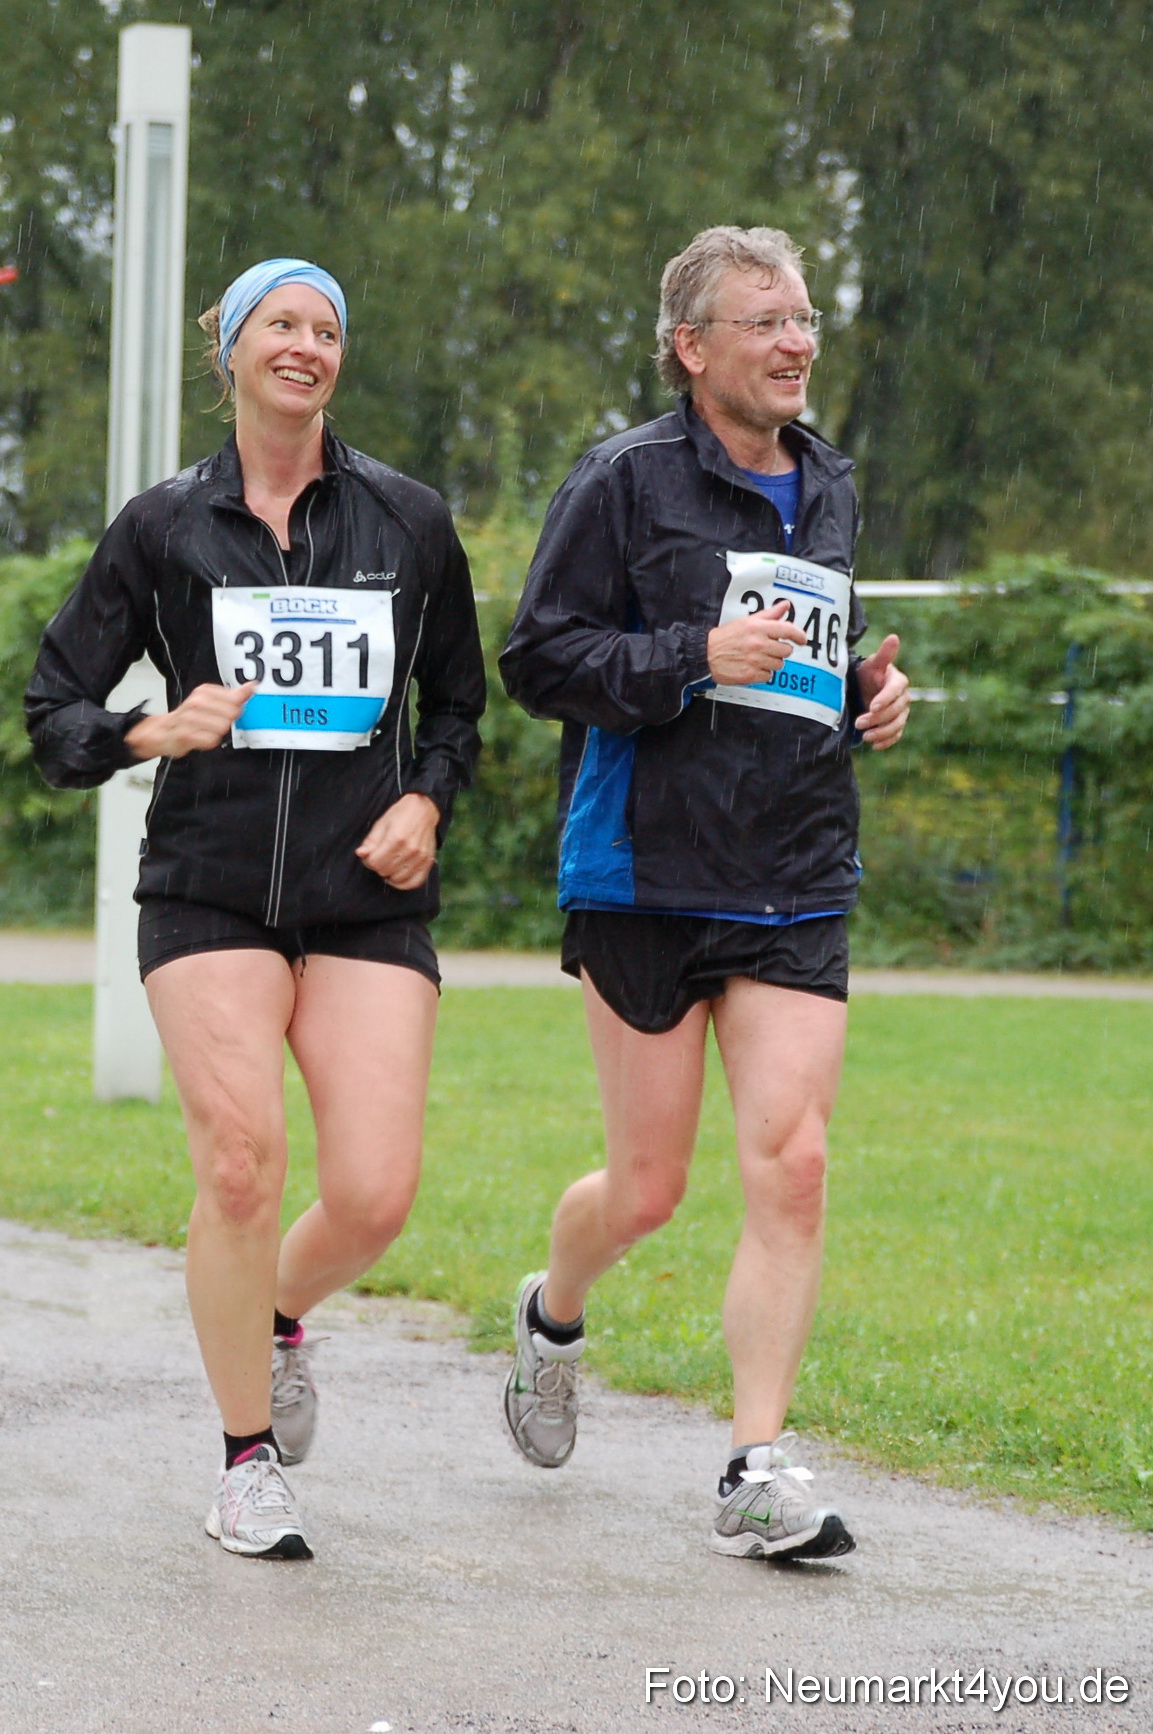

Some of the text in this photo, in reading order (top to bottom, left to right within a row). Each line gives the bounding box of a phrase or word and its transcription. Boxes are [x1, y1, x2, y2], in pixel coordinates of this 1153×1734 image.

[775, 565, 825, 591] BOCK
[271, 598, 338, 614] BOCK
[234, 631, 370, 689] 3311
[766, 669, 816, 694] Josef
[282, 703, 329, 725] Ines
